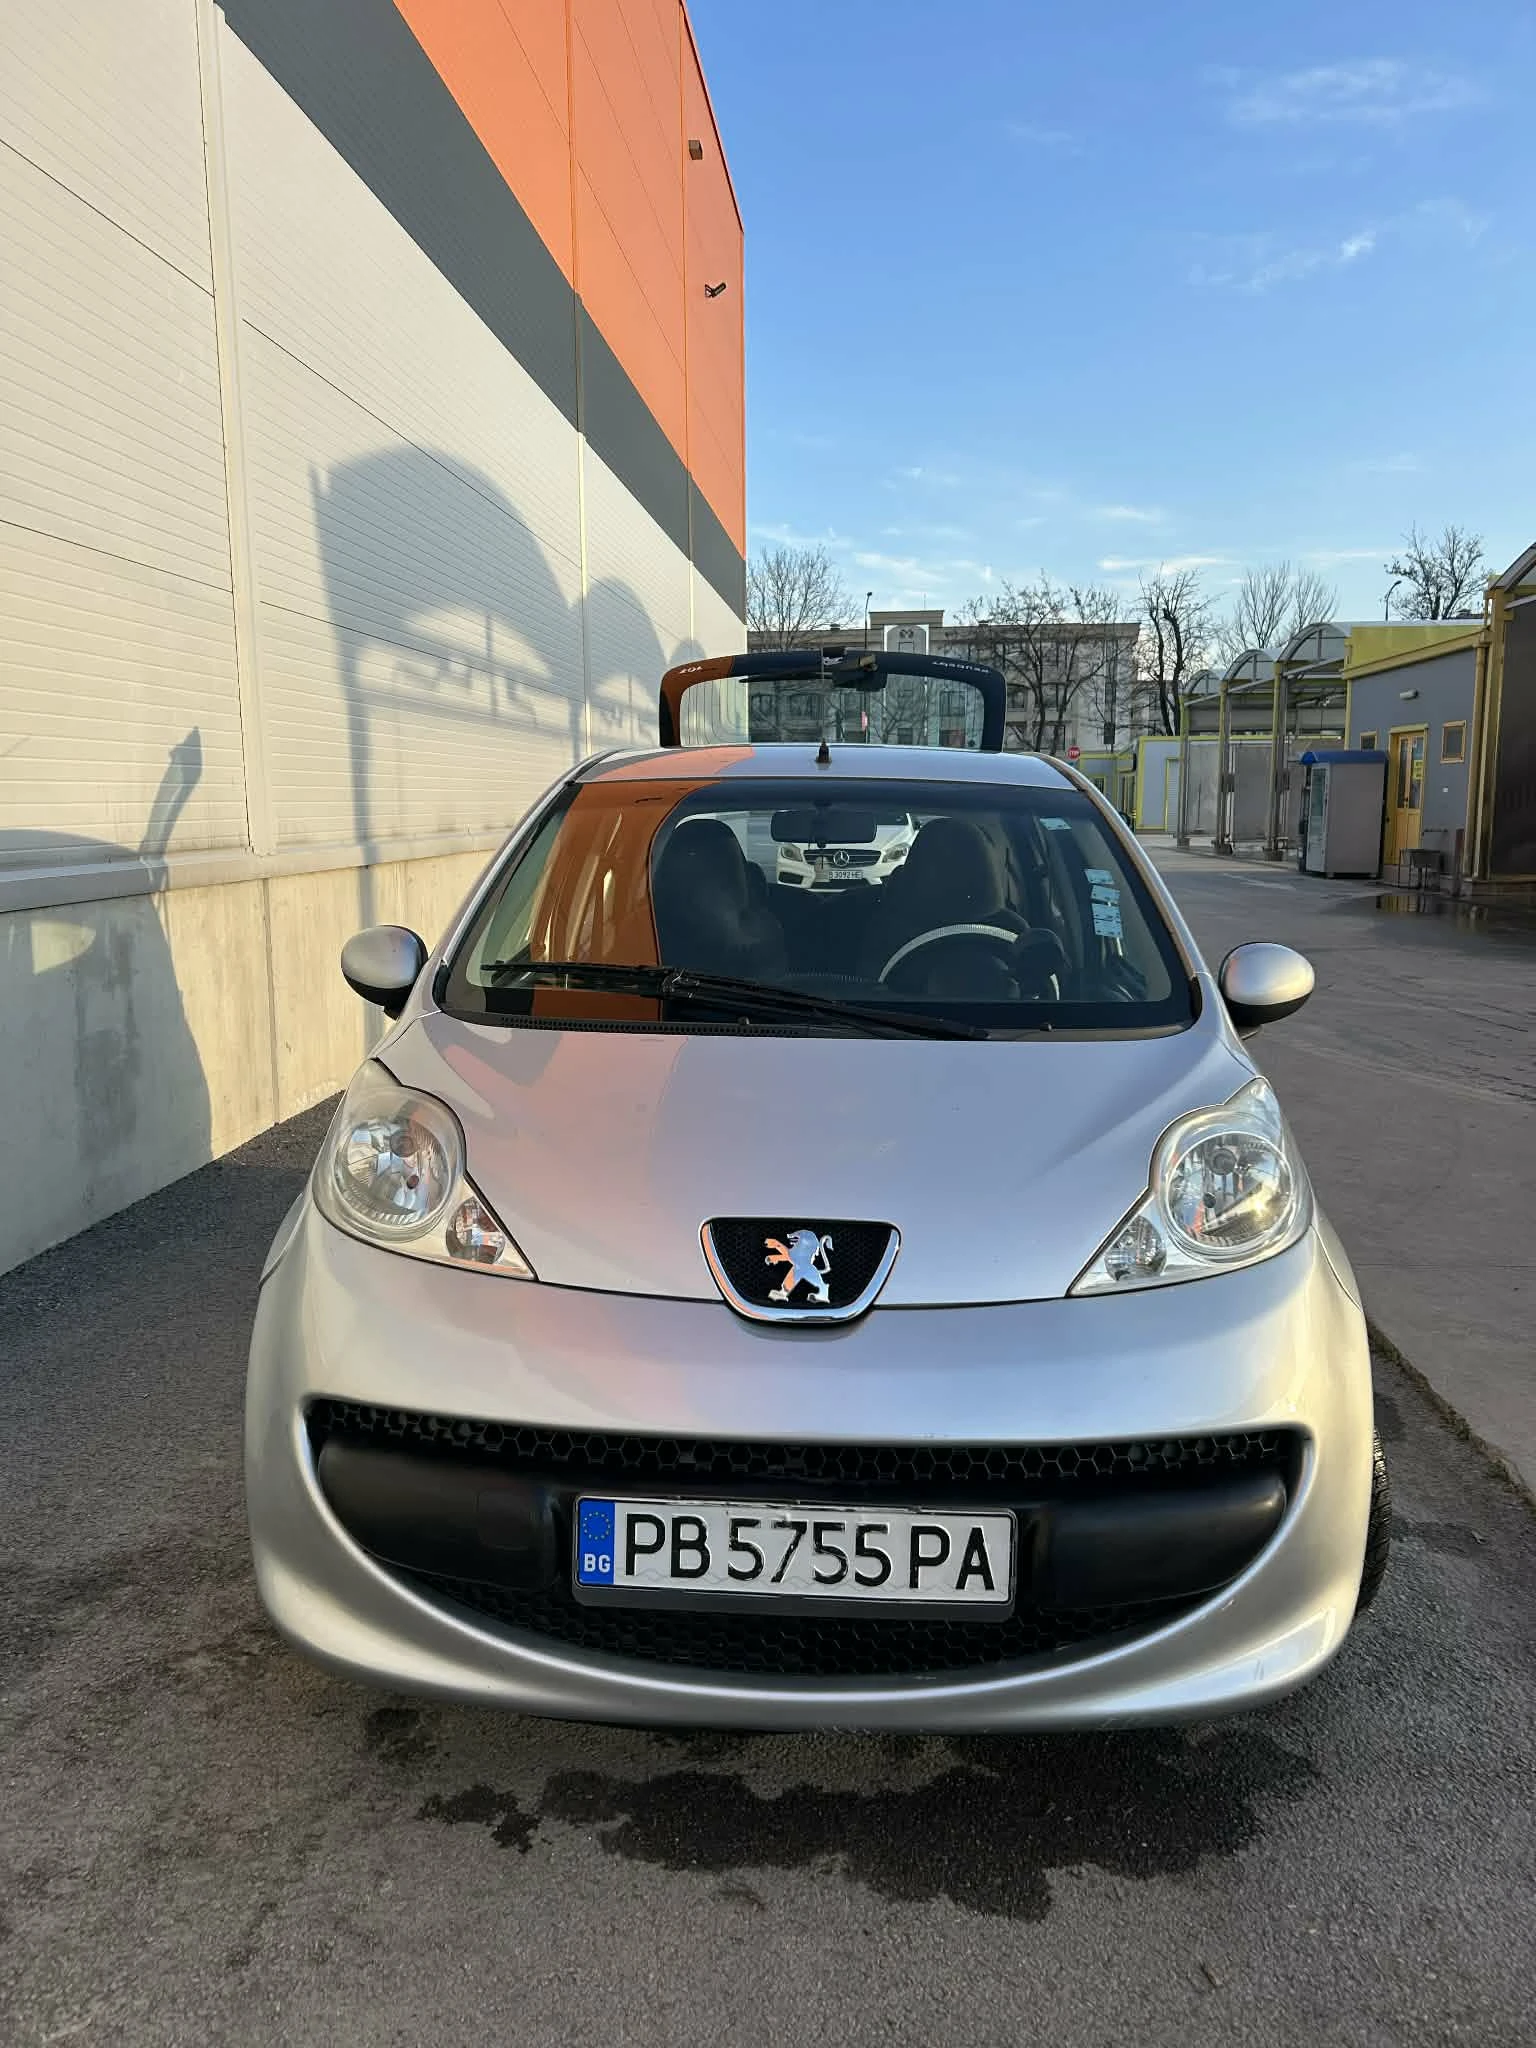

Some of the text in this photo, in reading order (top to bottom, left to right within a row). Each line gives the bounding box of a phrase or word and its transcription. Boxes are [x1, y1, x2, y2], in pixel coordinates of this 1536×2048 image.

[584, 1553, 611, 1573] BG
[624, 1512, 996, 1591] PB 5755 PA
